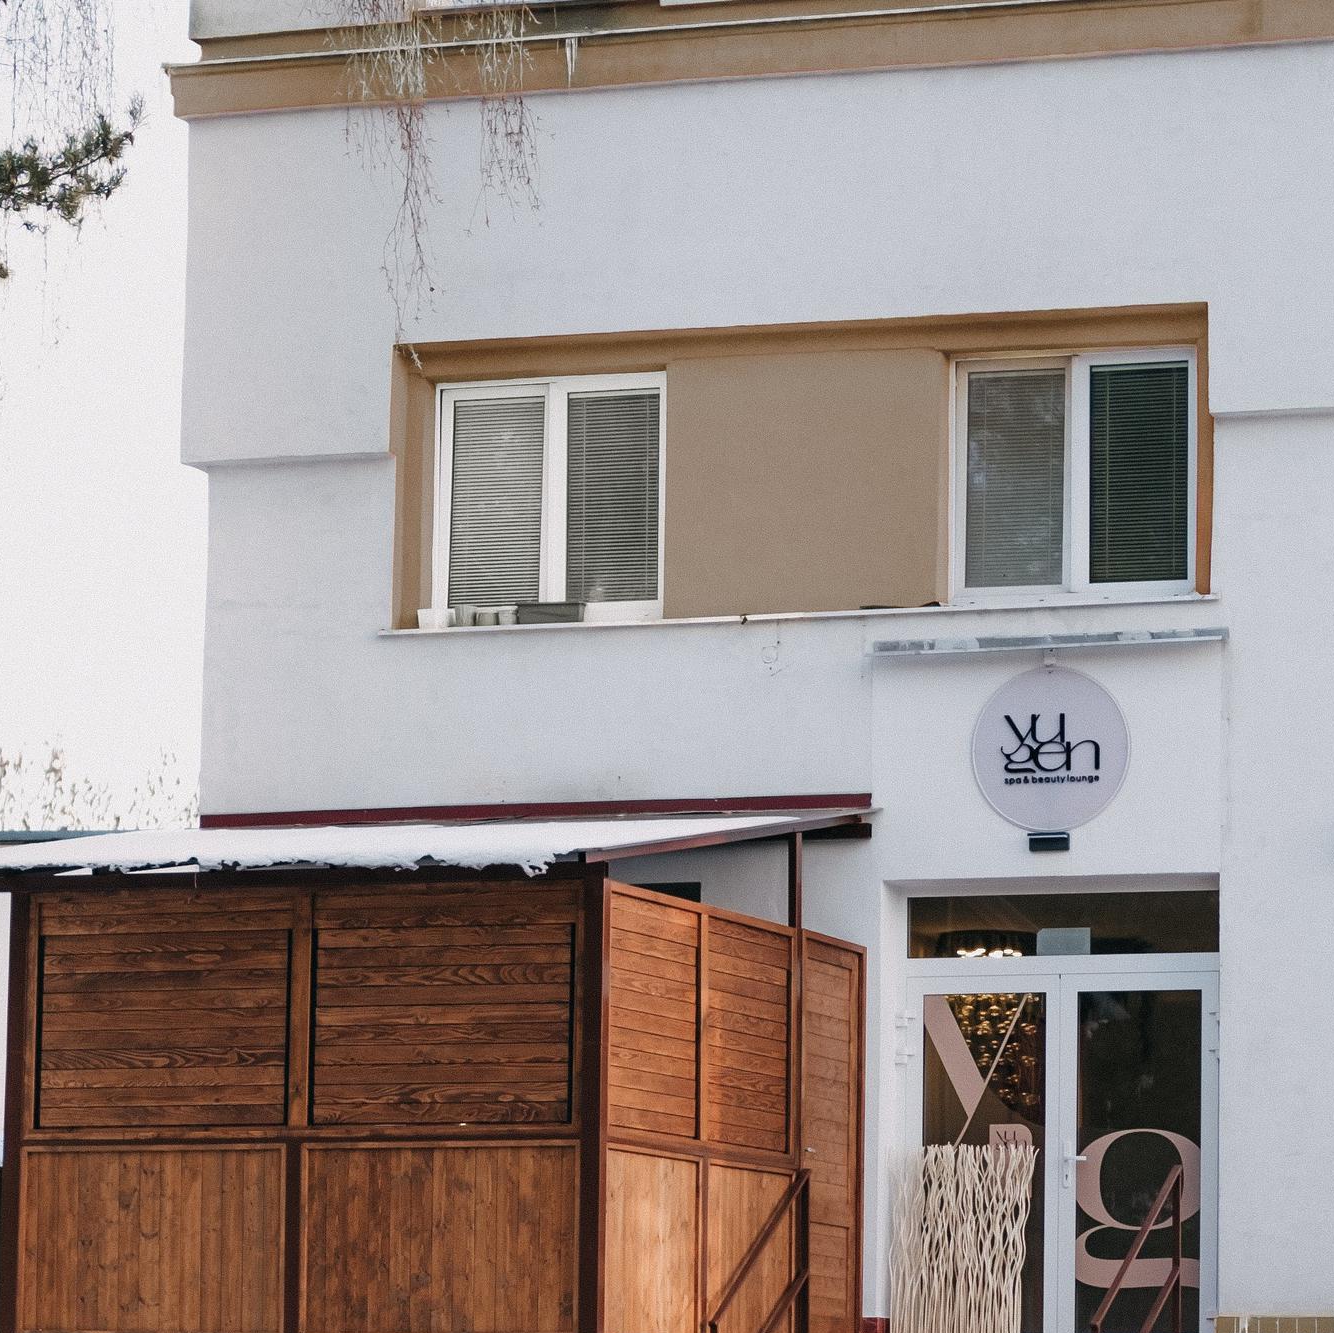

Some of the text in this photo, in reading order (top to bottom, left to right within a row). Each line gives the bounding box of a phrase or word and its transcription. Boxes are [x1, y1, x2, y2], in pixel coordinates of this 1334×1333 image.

[1001, 713, 1065, 756] yu
[1004, 740, 1100, 773] gen
[1004, 777, 1022, 785] spa
[1032, 775, 1065, 783] beauty
[1067, 774, 1100, 783] lounge
